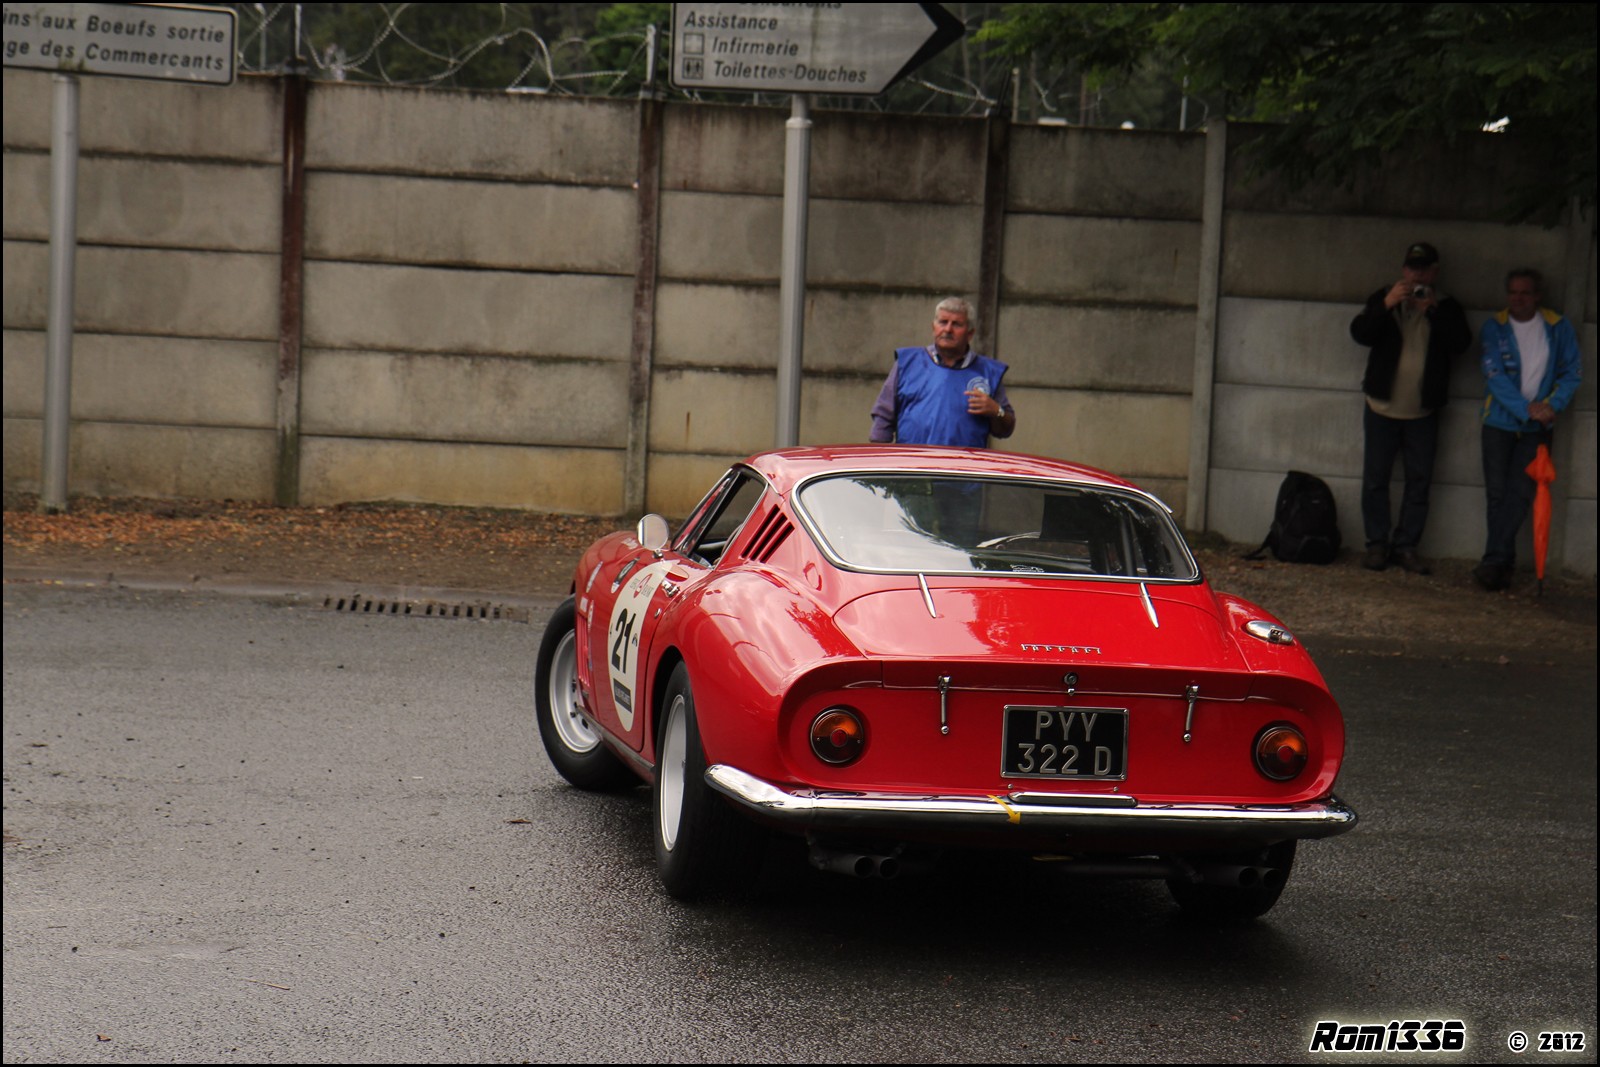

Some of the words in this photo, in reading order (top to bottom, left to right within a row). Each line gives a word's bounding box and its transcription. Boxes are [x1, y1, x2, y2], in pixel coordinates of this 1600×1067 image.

[42, 15, 76, 30] aux
[86, 15, 157, 38] Boeufs
[167, 25, 225, 43] sortie
[685, 11, 778, 31] Assistance
[40, 40, 75, 58] des
[85, 43, 224, 71] Commercants
[712, 36, 799, 57] Infirmerie
[714, 60, 867, 83] Toilettes-Douches
[611, 608, 637, 674] 21
[1035, 710, 1098, 742] PYY
[1017, 743, 1079, 775] 322
[1094, 746, 1112, 776] D
